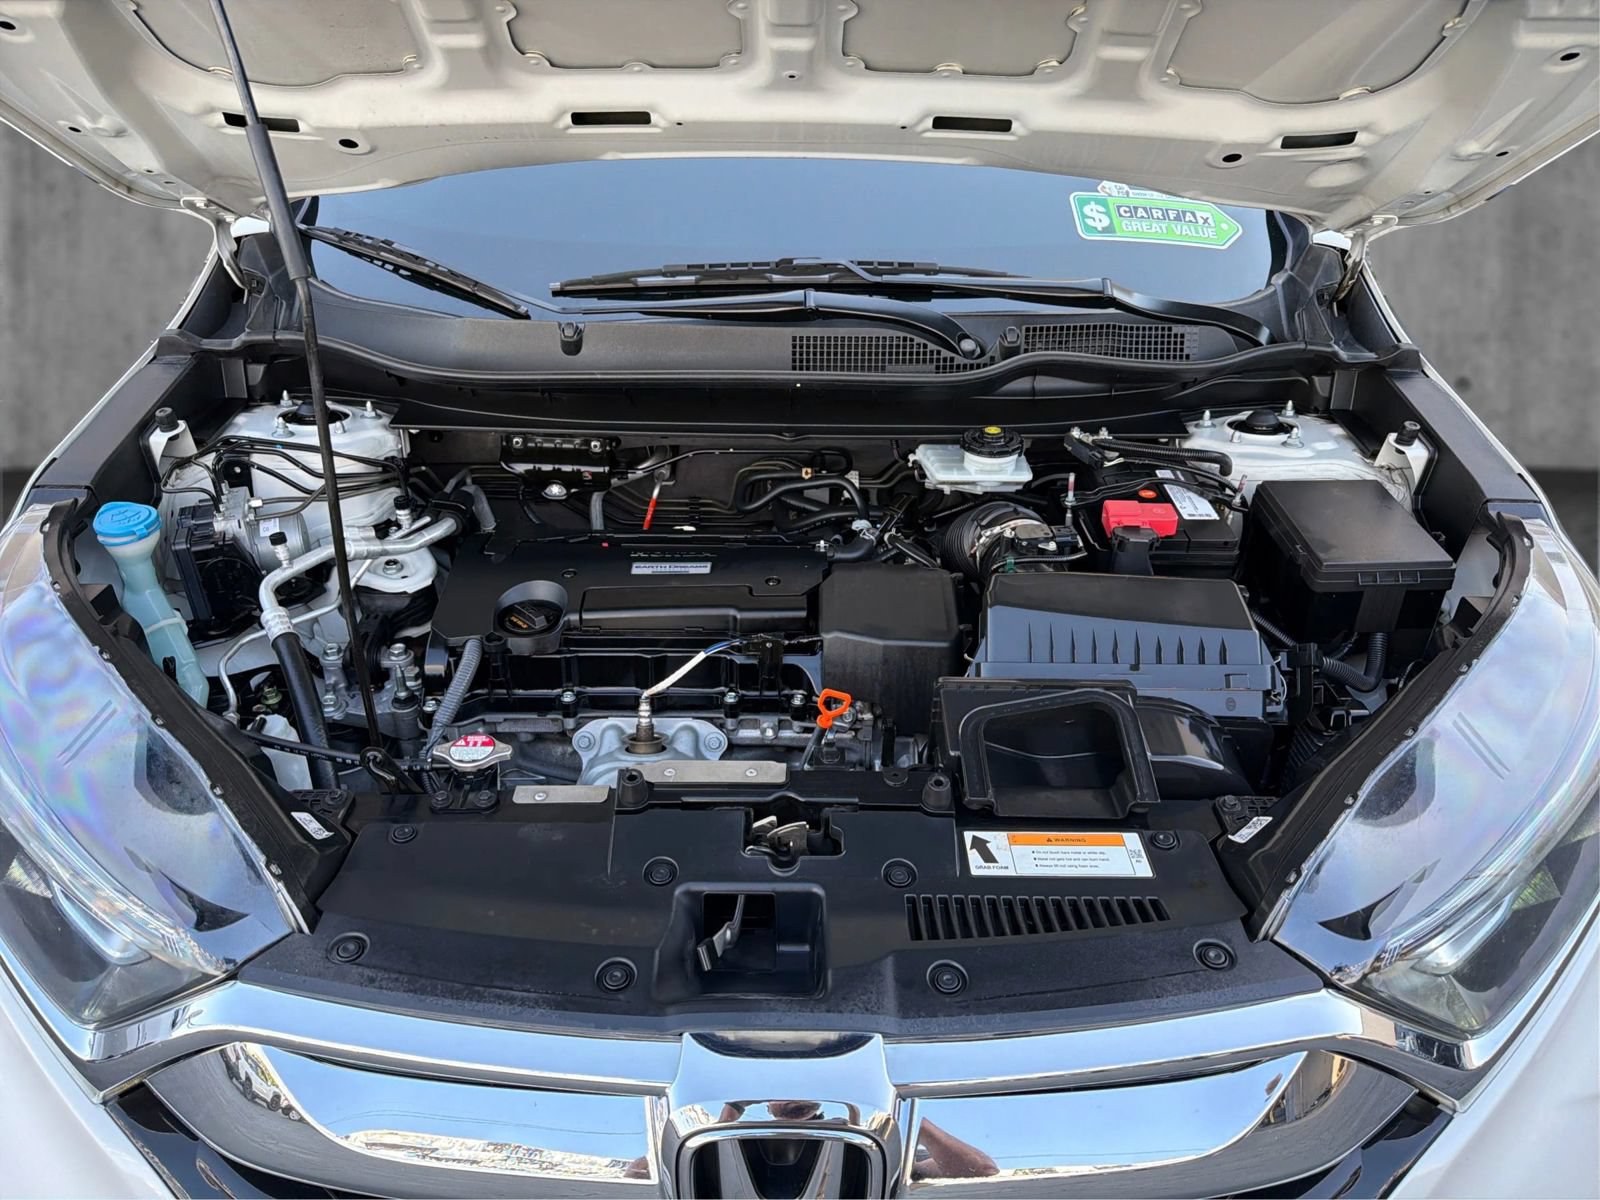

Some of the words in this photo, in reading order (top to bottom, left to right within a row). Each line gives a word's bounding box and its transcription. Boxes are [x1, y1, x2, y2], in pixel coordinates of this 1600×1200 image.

[1117, 205, 1213, 226] CARFAX
[1122, 220, 1168, 235] GREAT
[1173, 223, 1218, 239] VALUE
